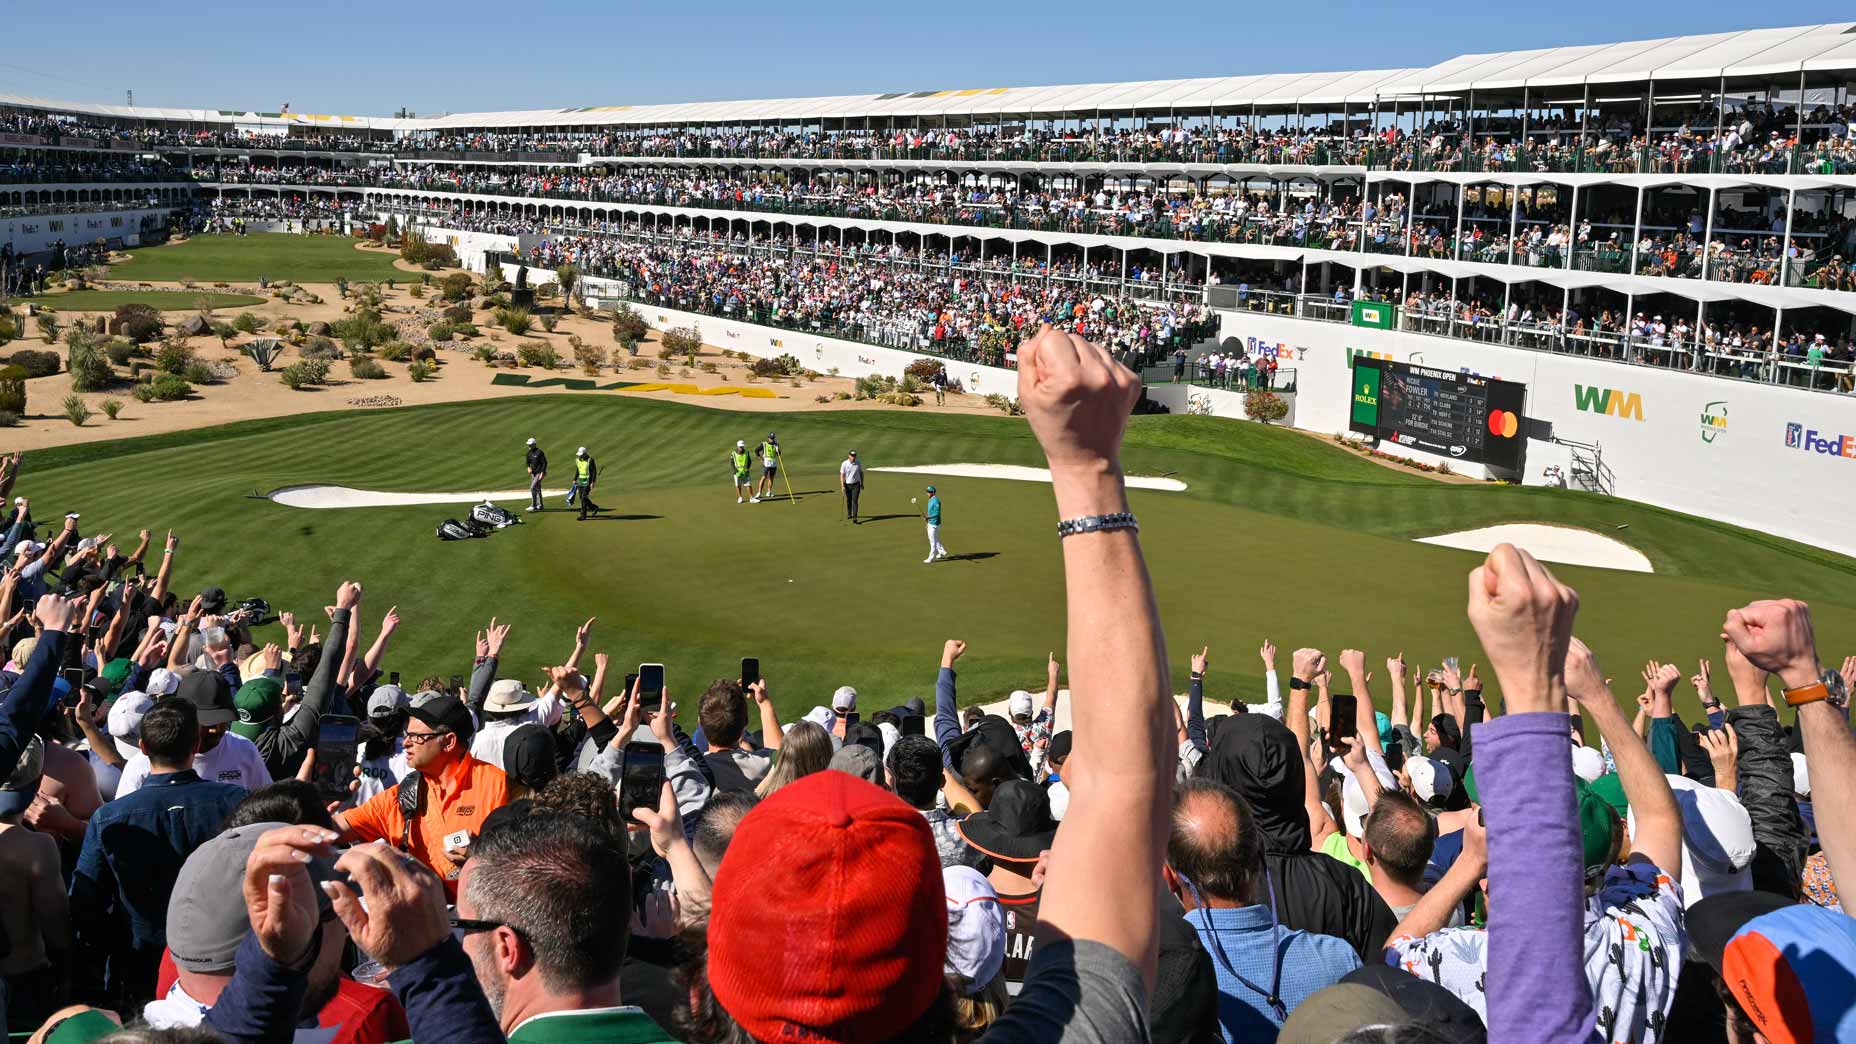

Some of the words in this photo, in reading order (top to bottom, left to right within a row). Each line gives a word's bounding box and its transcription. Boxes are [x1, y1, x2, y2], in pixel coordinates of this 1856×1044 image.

[1364, 311, 1378, 320] WM
[1257, 341, 1294, 360] FedEx
[1409, 366, 1420, 375] WM
[1420, 367, 1442, 379] PHOENIX
[1442, 371, 1457, 382] OPEN
[1405, 385, 1428, 396] FOWLER
[1355, 394, 1377, 406] ROLEX
[1574, 383, 1645, 422] WM
[1700, 413, 1727, 428] WM
[1804, 429, 1856, 459] FedE
[477, 510, 502, 523] PING
